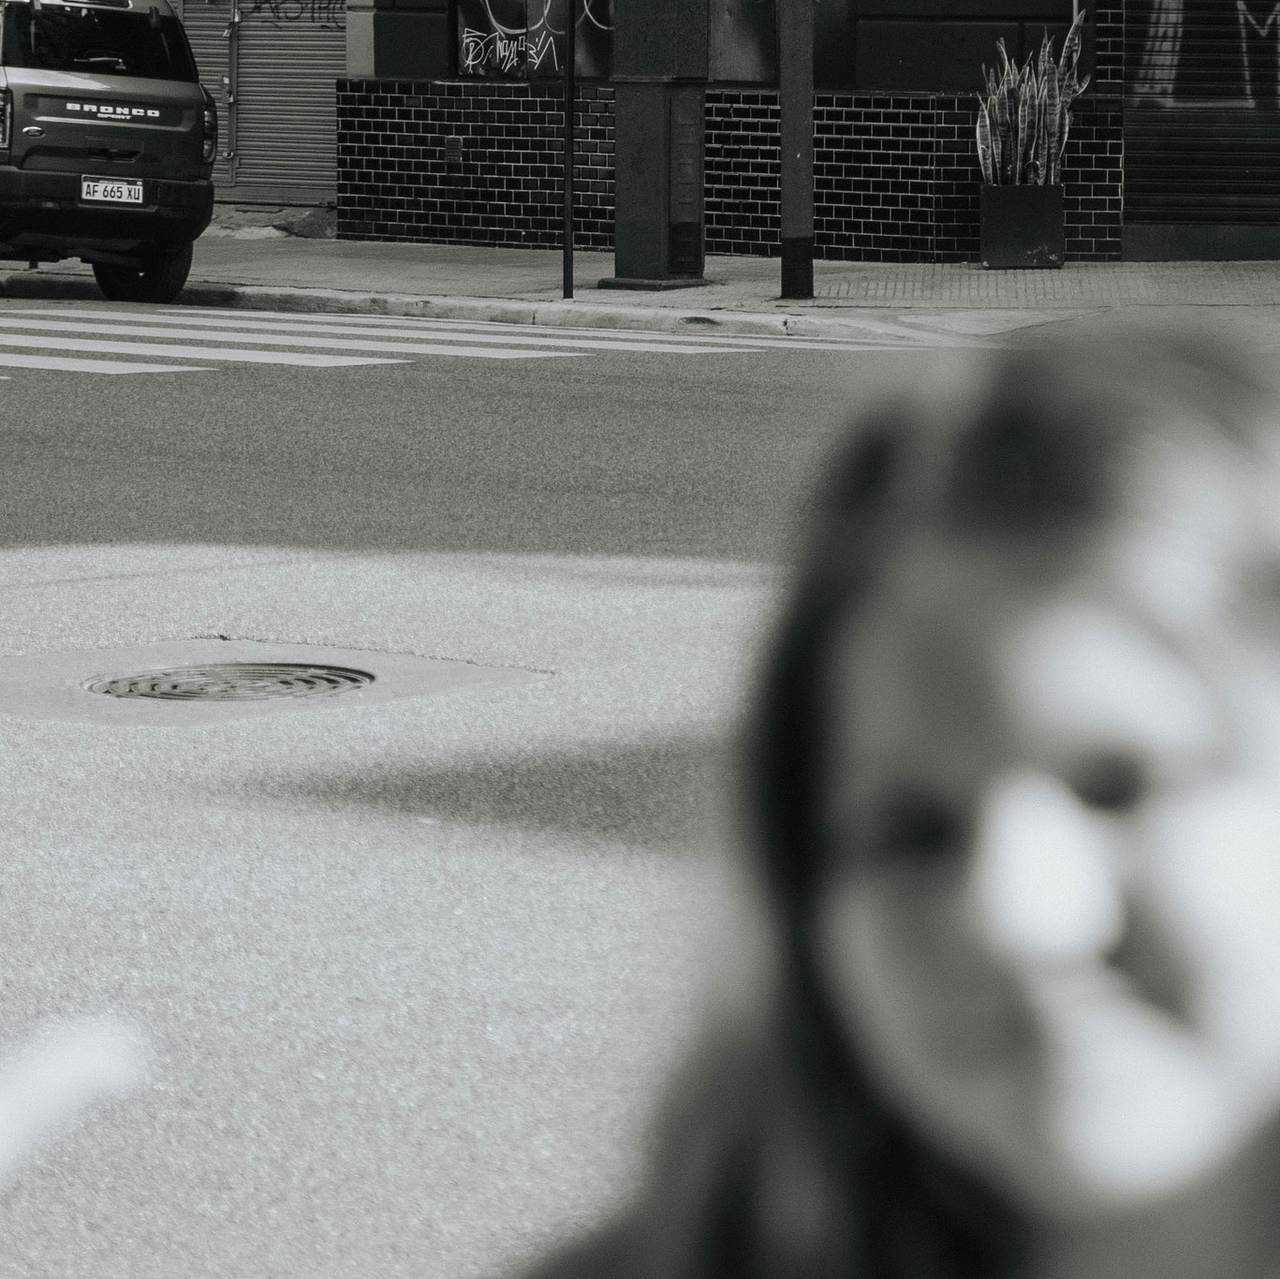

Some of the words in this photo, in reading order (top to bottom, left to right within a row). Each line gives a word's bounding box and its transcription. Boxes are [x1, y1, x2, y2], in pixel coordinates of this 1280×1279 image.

[66, 103, 160, 117] BRONCO
[86, 184, 99, 197] AF
[102, 185, 122, 199] 665
[127, 187, 140, 200] XU
